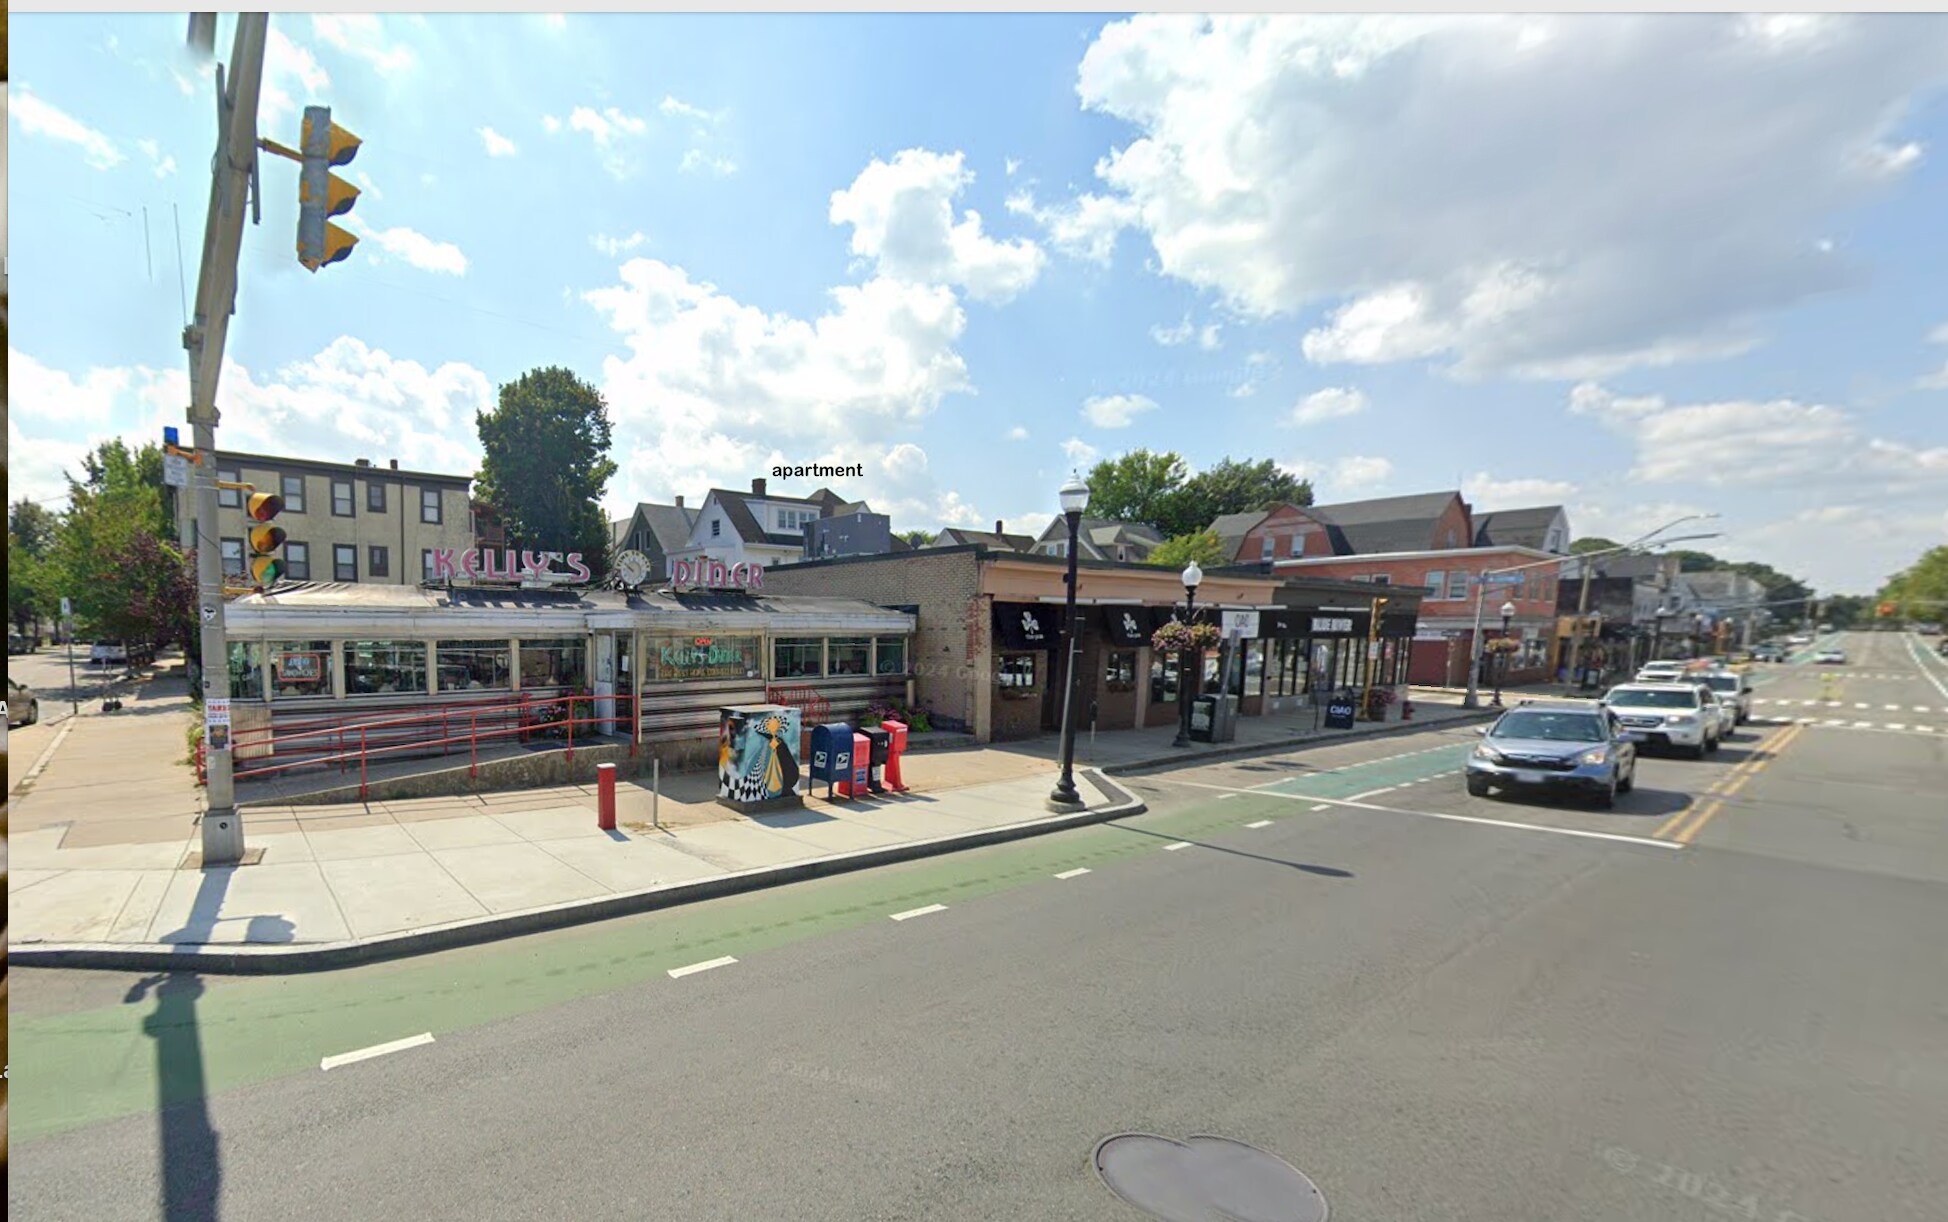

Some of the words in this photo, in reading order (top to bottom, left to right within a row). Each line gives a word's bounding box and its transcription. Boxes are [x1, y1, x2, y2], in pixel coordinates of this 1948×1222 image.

[432, 549, 591, 583] KELLY'S
[673, 560, 764, 588] DINER
[1330, 705, 1351, 715] CIAO
